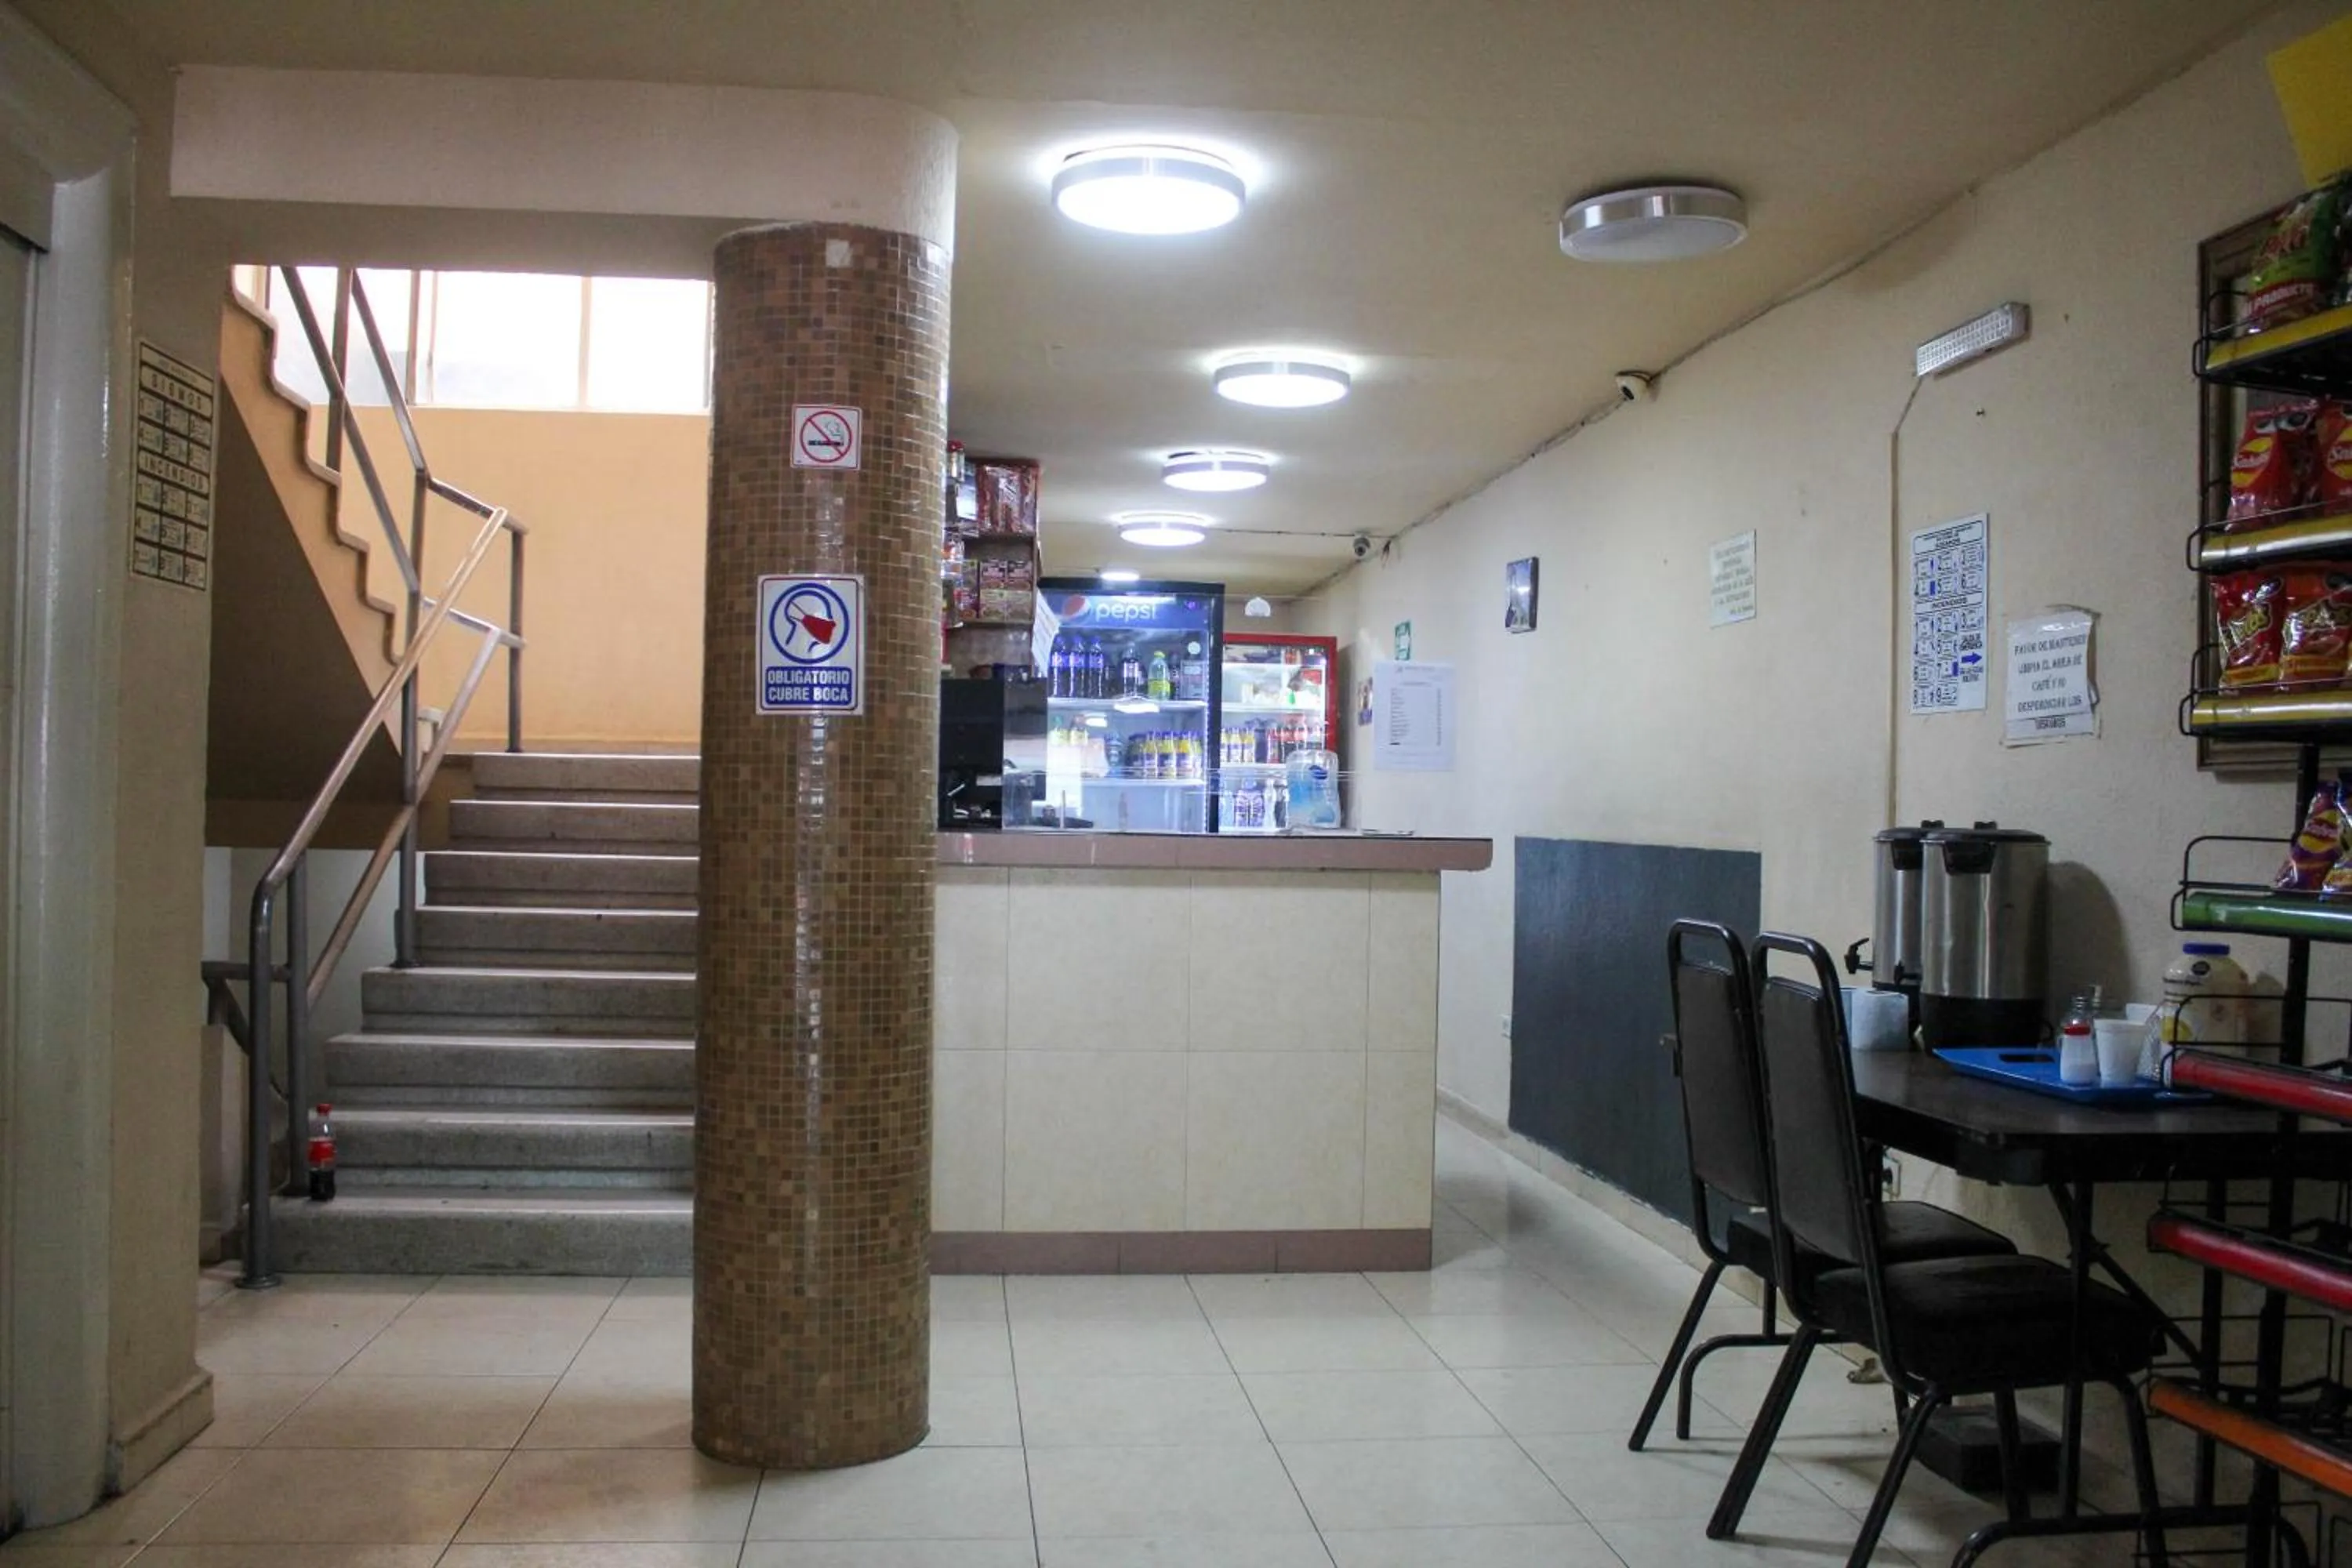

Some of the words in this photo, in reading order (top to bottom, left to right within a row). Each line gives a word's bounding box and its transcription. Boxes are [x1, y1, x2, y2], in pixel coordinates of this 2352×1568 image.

[1095, 601, 1156, 624] pepsi
[768, 670, 849, 684] OBLIGATORIO
[768, 686, 810, 701] CUBRE
[813, 686, 848, 701] BOCA
